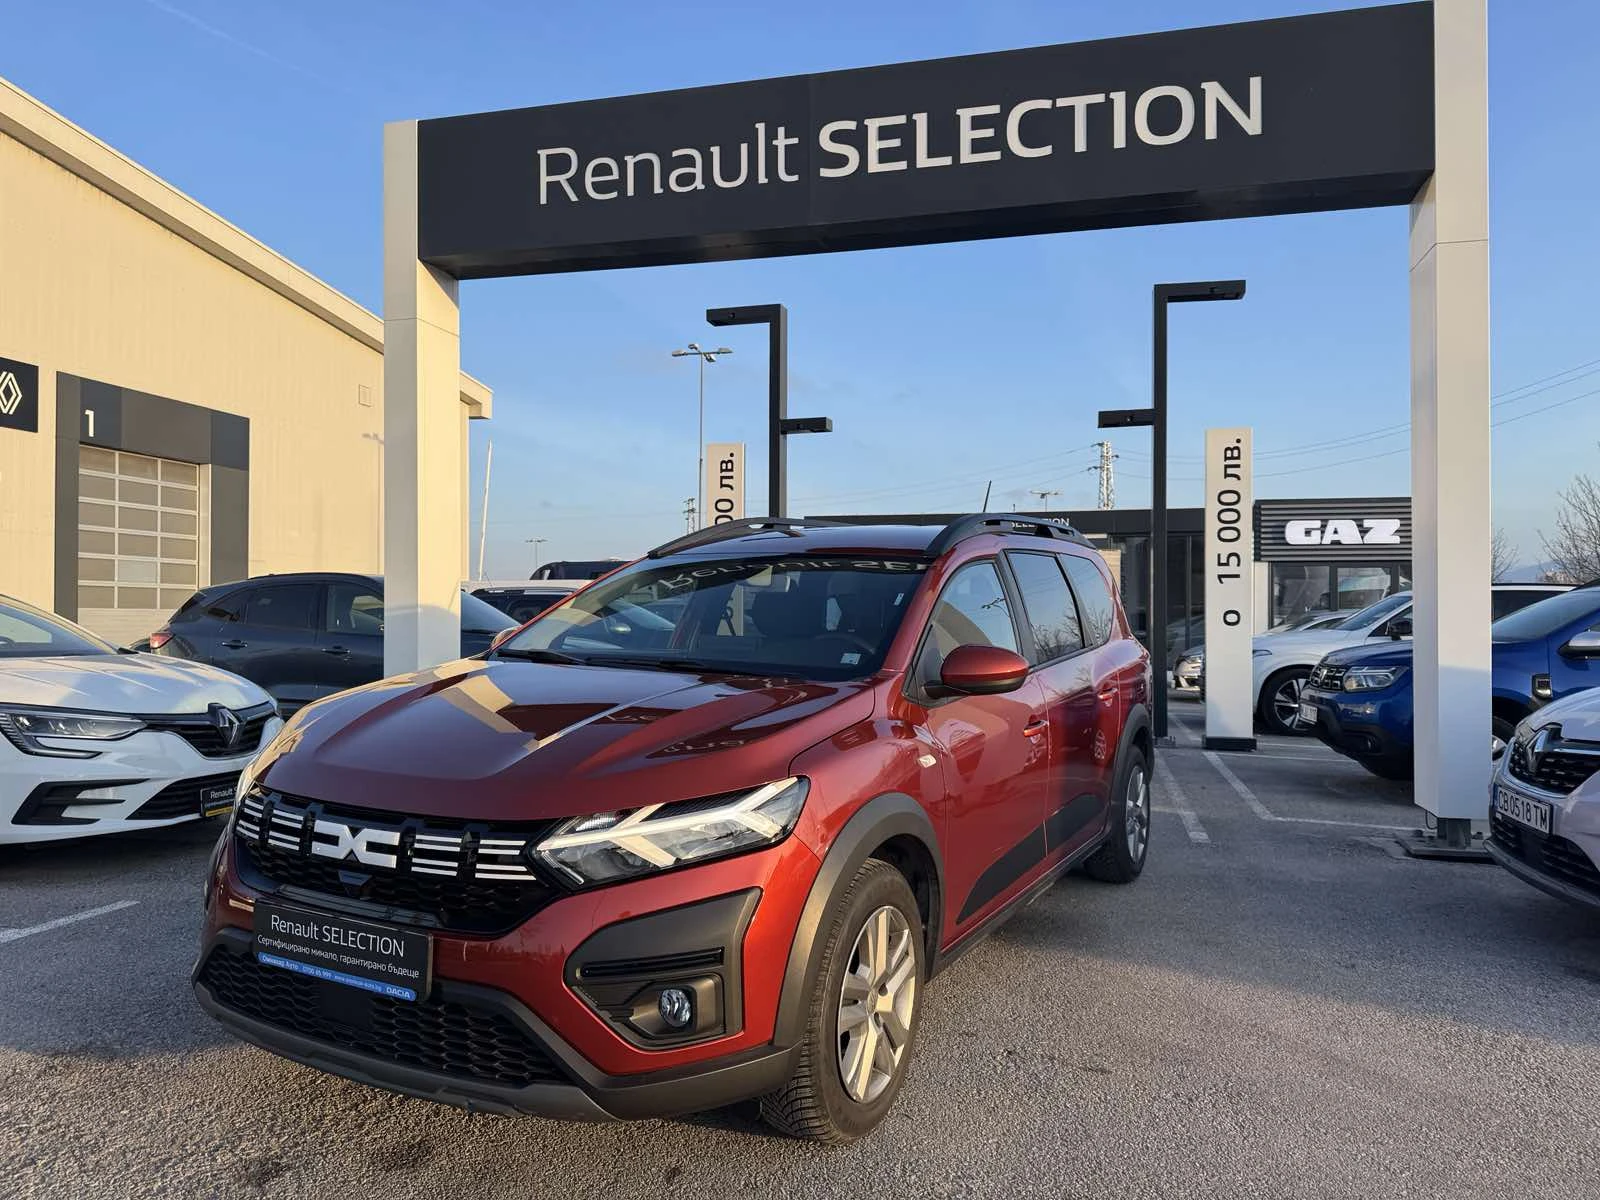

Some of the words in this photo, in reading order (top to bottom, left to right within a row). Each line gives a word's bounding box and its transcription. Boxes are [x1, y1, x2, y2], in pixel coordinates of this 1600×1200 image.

[537, 121, 799, 206] Renault
[818, 75, 1265, 179] SELECTION
[84, 408, 96, 438] 1
[719, 452, 734, 491] лв.
[1223, 437, 1241, 481] лв.
[1216, 489, 1241, 543] 000
[1284, 518, 1401, 545] GAZ
[1216, 551, 1241, 585] 15
[1498, 790, 1508, 812] CB
[1509, 795, 1532, 822] 0518
[271, 914, 319, 941] Renault
[322, 925, 405, 958] SELECTION
[387, 964, 420, 979] бъдеще
